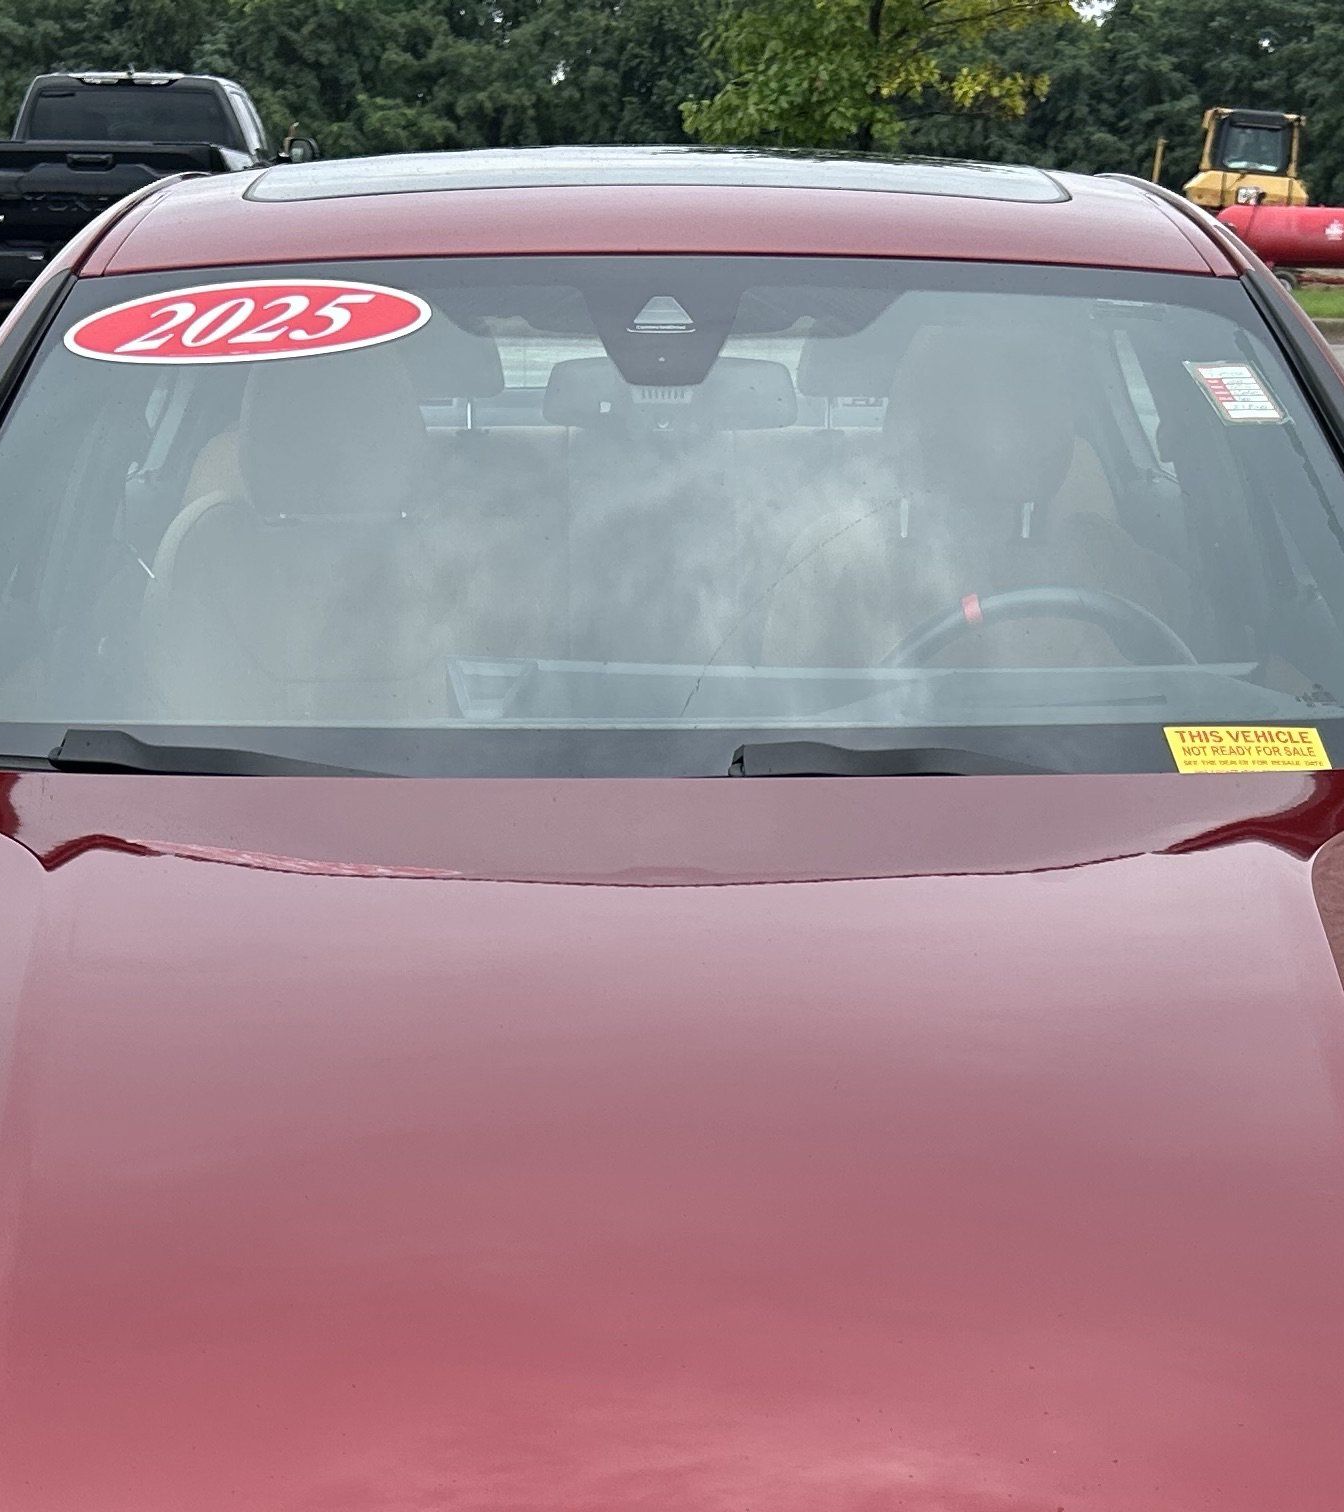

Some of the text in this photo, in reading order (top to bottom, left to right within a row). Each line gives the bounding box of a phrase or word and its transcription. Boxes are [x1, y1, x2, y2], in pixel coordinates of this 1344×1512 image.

[113, 294, 376, 353] 2025
[1174, 730, 1313, 744] THIS VEHICLE
[1182, 745, 1316, 757] NOT READY FOR SALE
